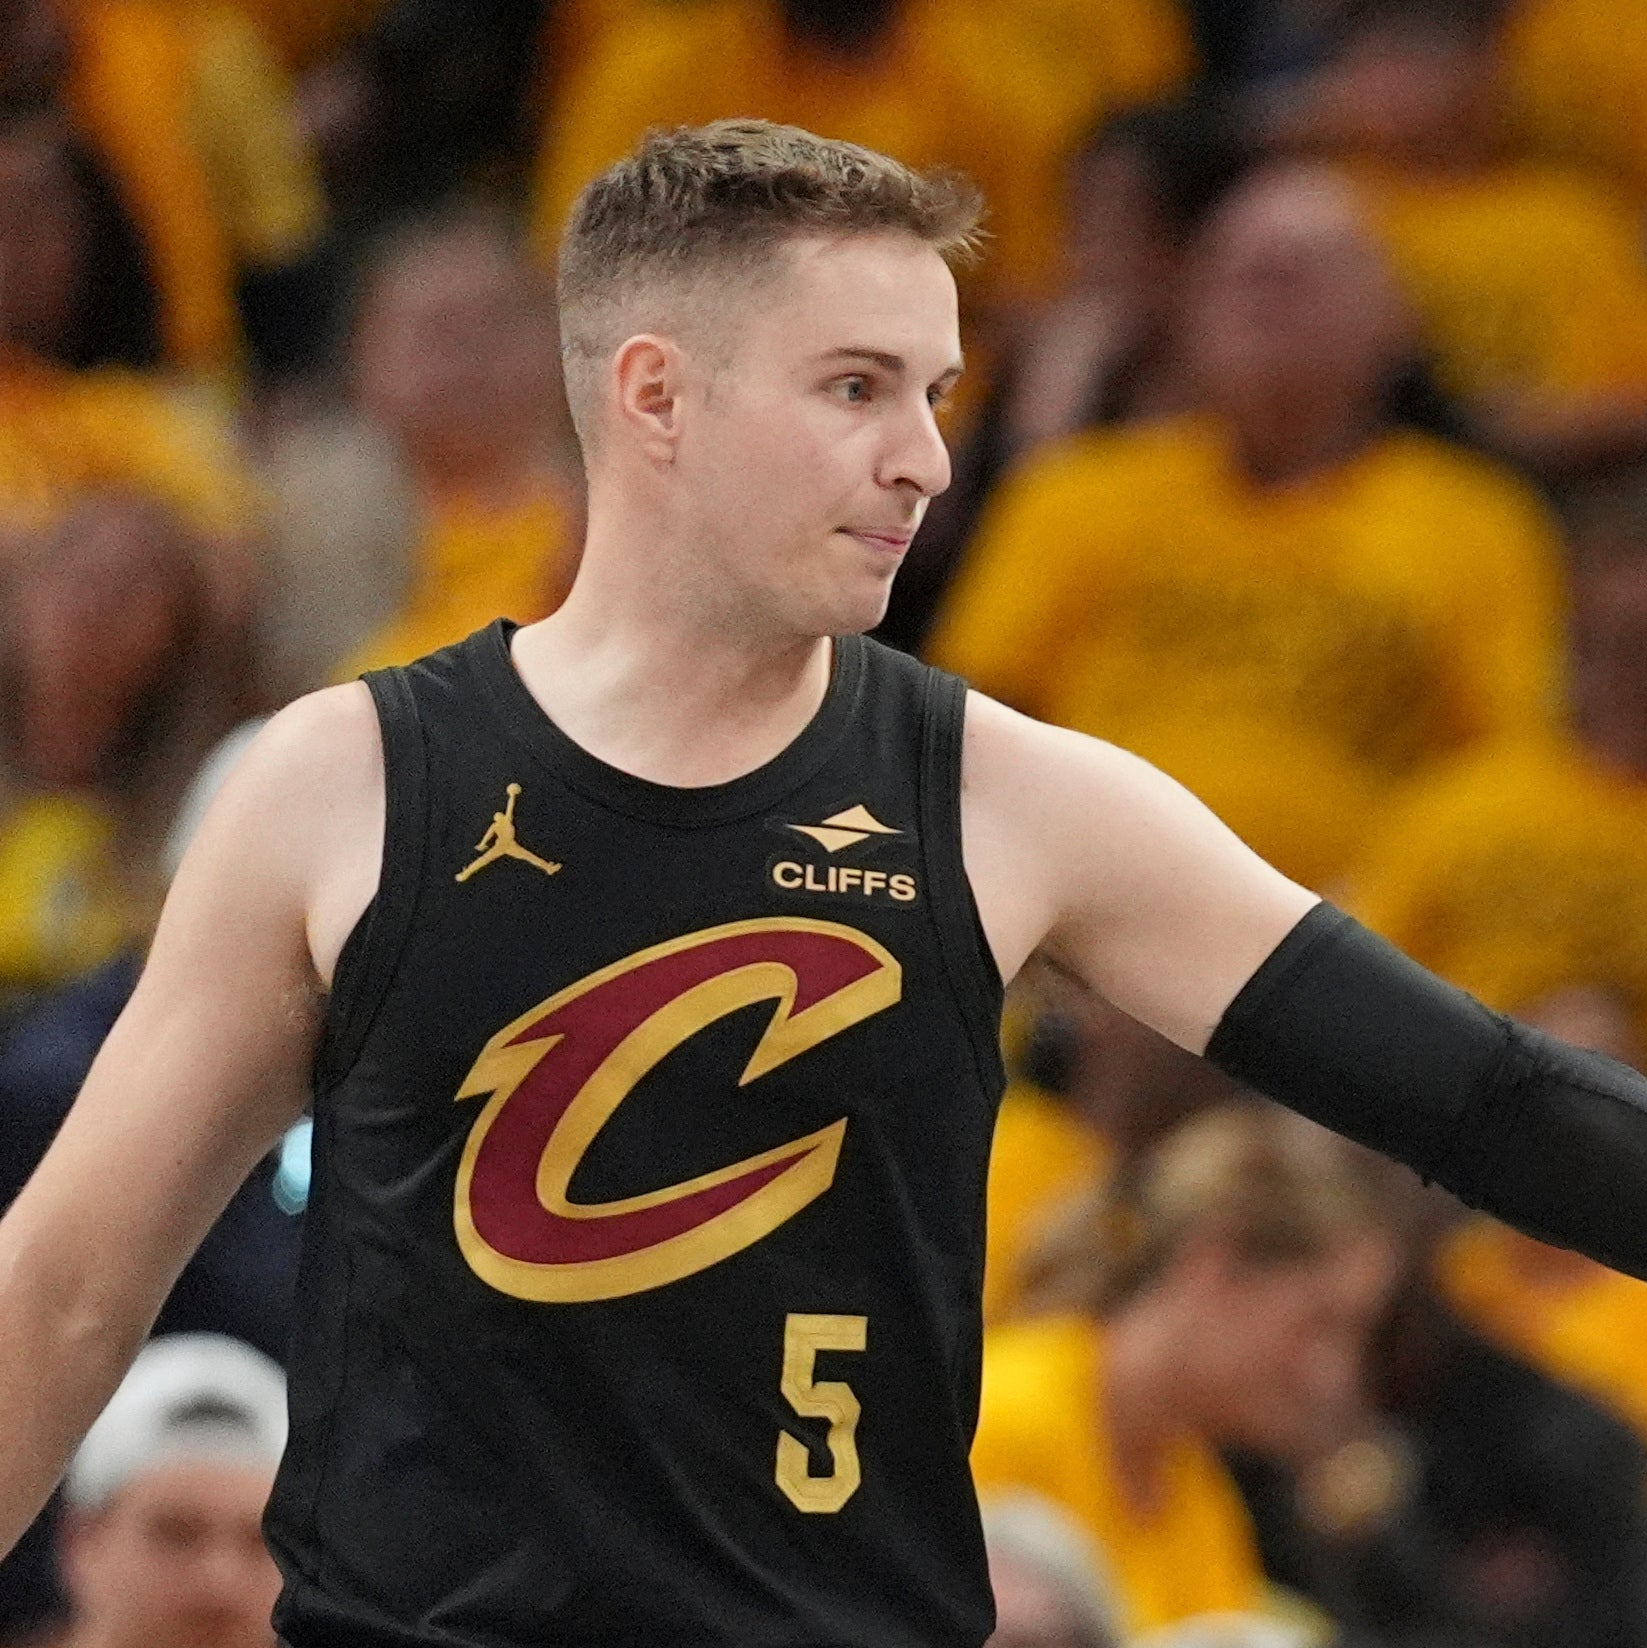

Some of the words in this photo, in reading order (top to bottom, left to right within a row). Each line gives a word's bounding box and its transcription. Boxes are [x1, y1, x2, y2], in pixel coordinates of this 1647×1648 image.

[772, 861, 917, 901] CLIFFS
[454, 916, 902, 1303] C
[775, 1313, 868, 1514] 5
